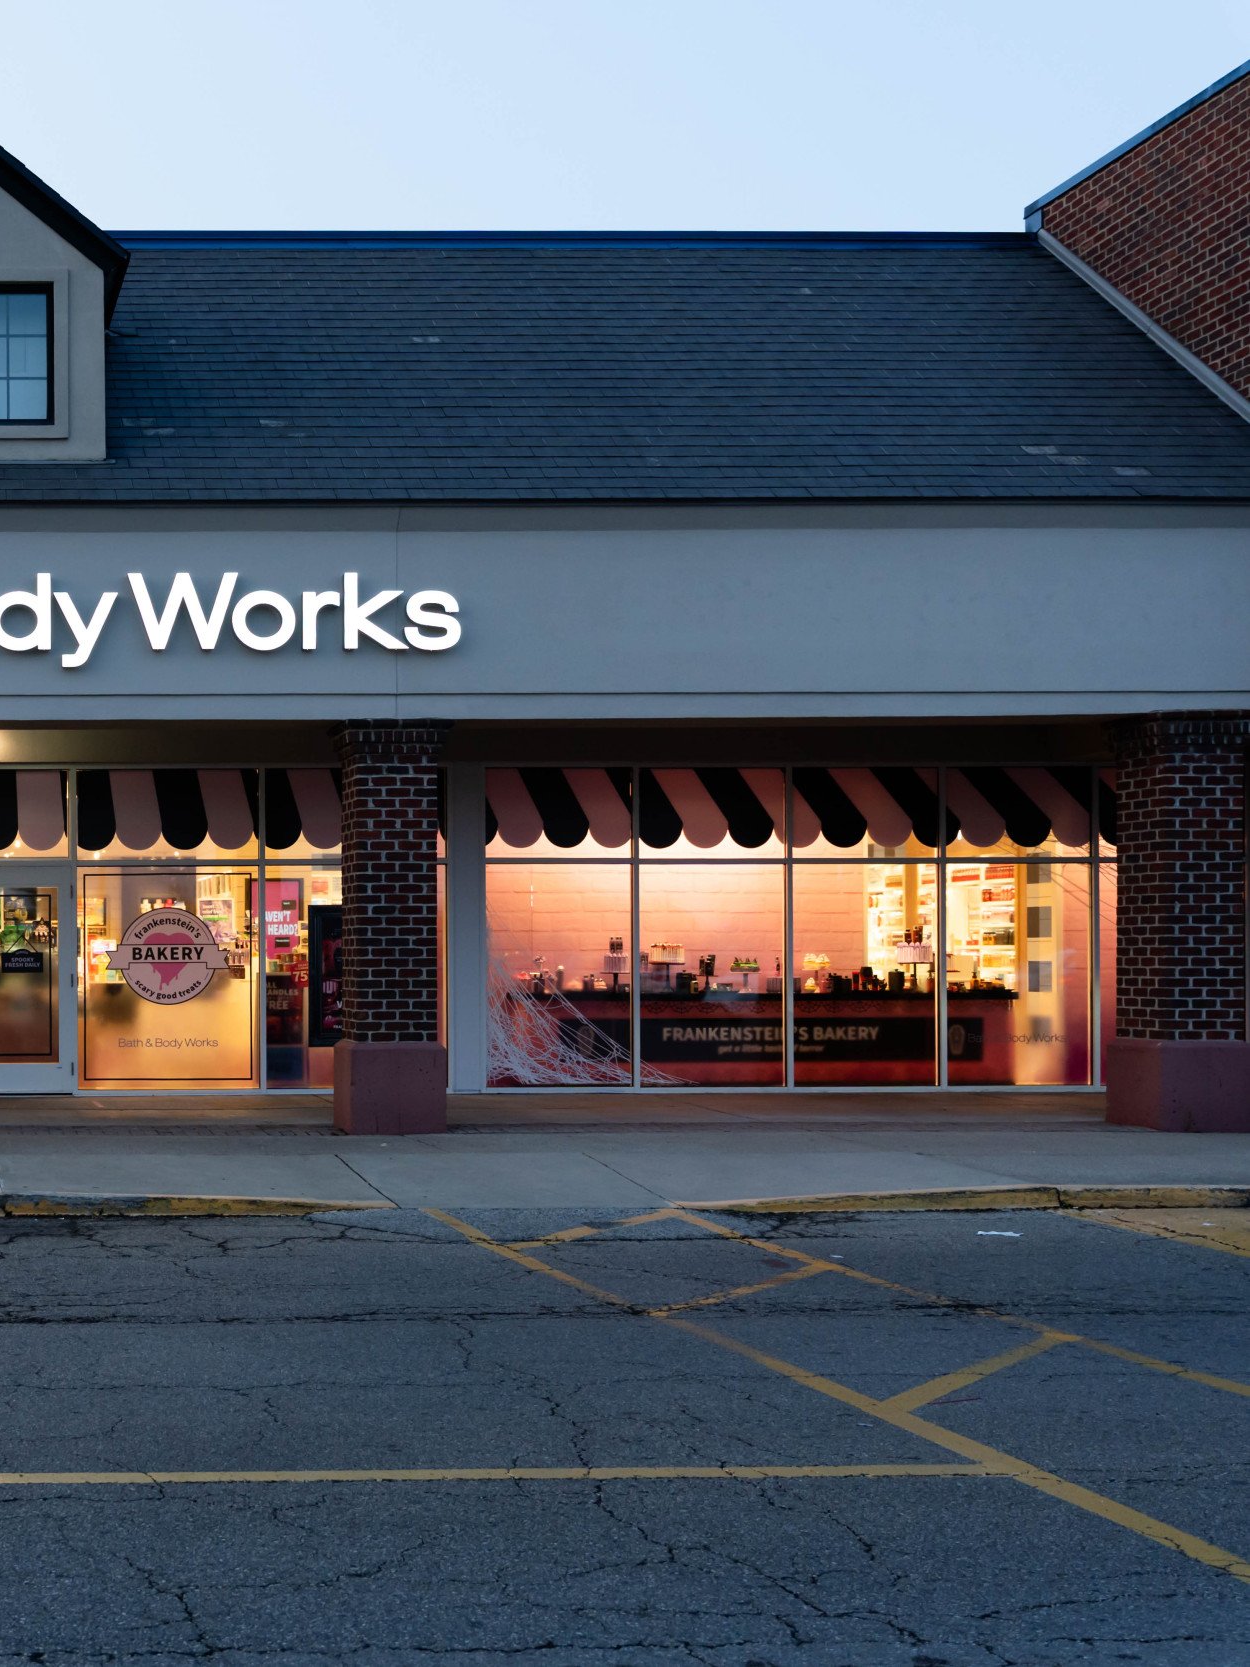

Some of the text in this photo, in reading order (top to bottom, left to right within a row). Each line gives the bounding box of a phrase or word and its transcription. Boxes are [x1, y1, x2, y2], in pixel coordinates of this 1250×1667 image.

[126, 571, 462, 651] Works
[265, 910, 291, 922] AVEN'T
[134, 917, 202, 940] frankenstein's
[267, 924, 299, 937] HEARD?
[132, 946, 205, 961] BAKERY
[293, 971, 308, 982] 75
[134, 980, 202, 1000] scary good treats
[267, 988, 299, 996] ANDLES
[268, 1000, 289, 1010] REE
[662, 1026, 880, 1041] FRANKENSTEI'S BAKERY
[118, 1038, 219, 1049] Bath & Body Works
